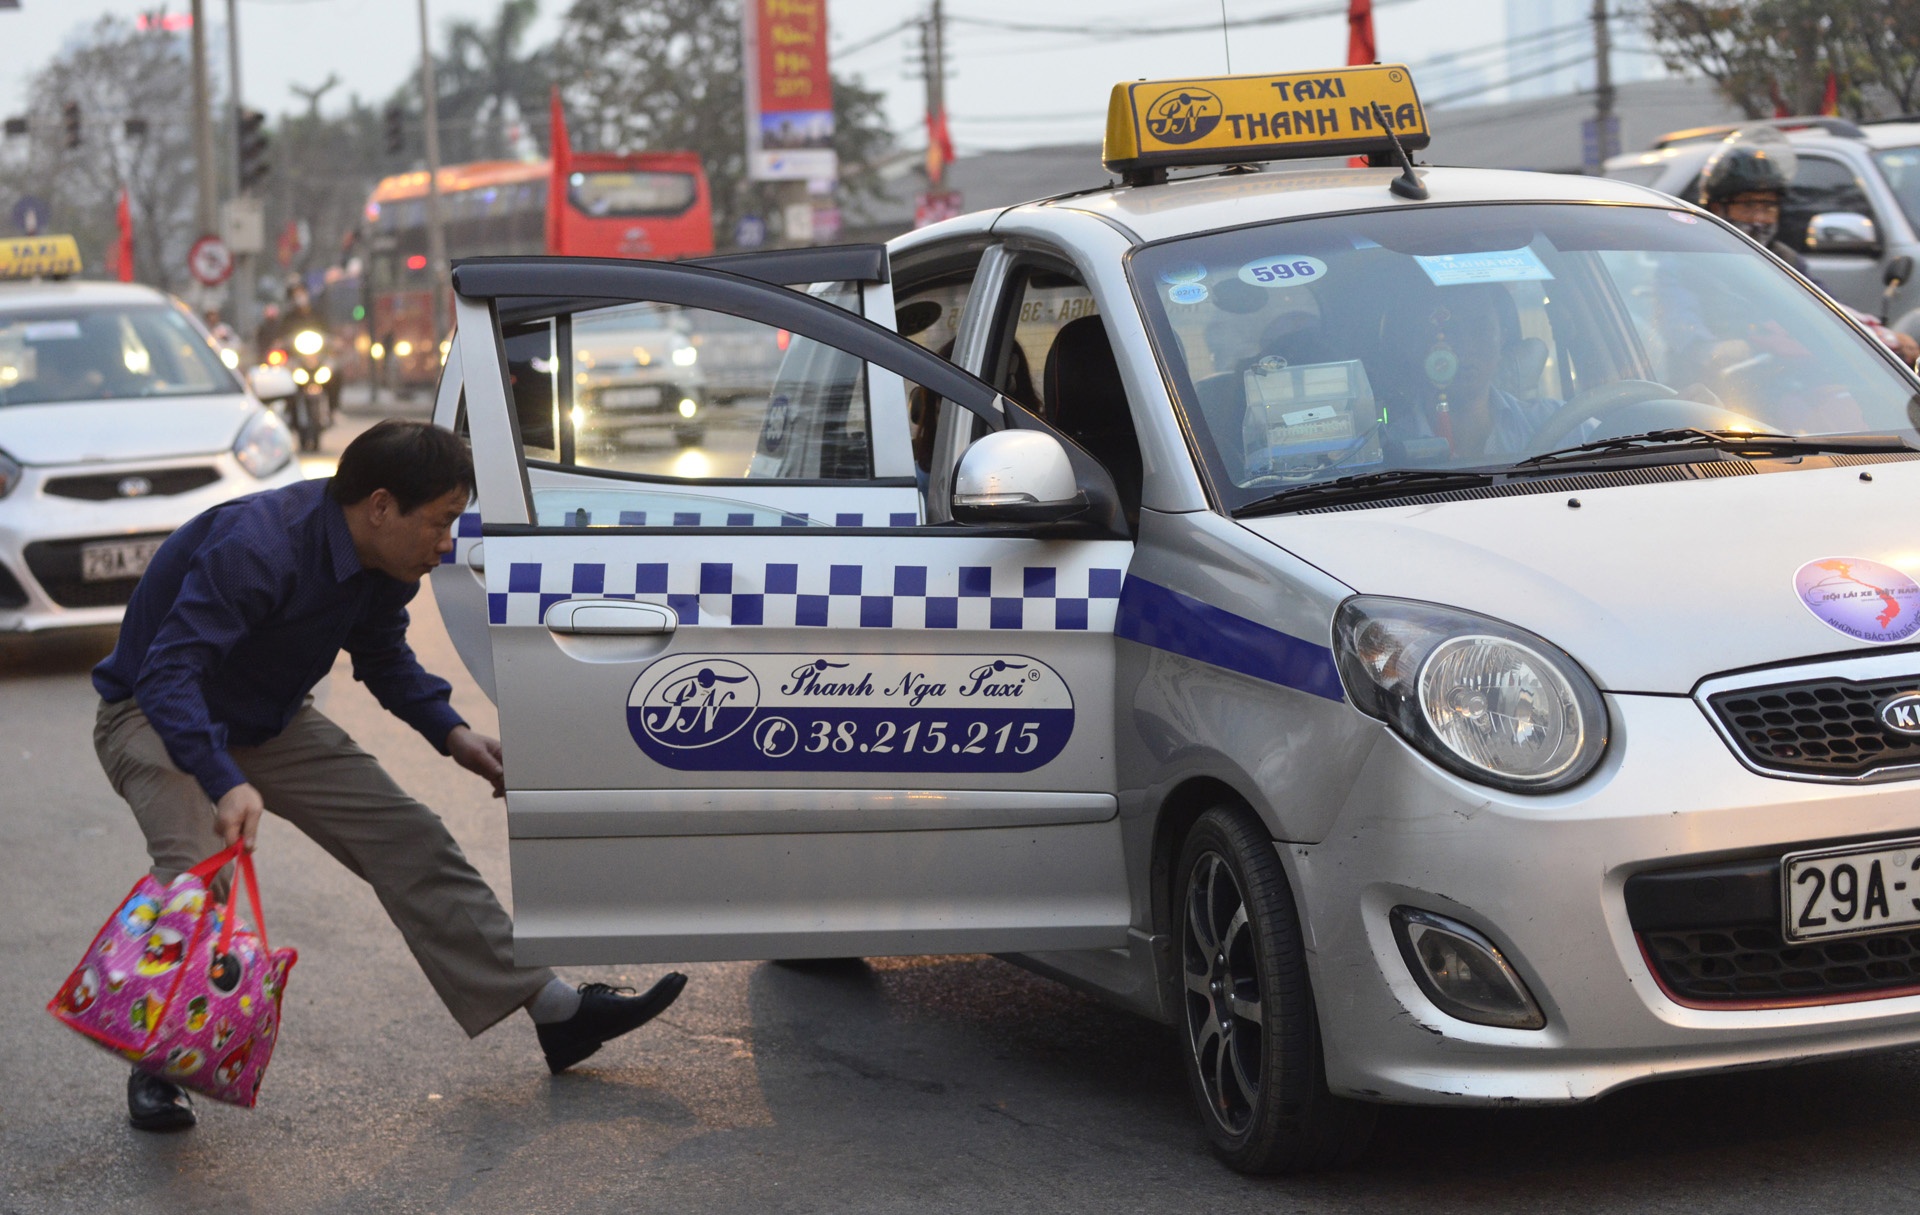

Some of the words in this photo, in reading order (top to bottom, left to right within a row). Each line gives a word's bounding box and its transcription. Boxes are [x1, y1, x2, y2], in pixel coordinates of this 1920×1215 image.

[1271, 78, 1346, 101] TAXI
[1225, 108, 1339, 141] THANH
[1348, 103, 1417, 131] NGA
[1251, 260, 1316, 283] 596
[781, 659, 875, 697] Thanh
[884, 671, 947, 707] Nga
[804, 720, 1041, 755] 38.215.215
